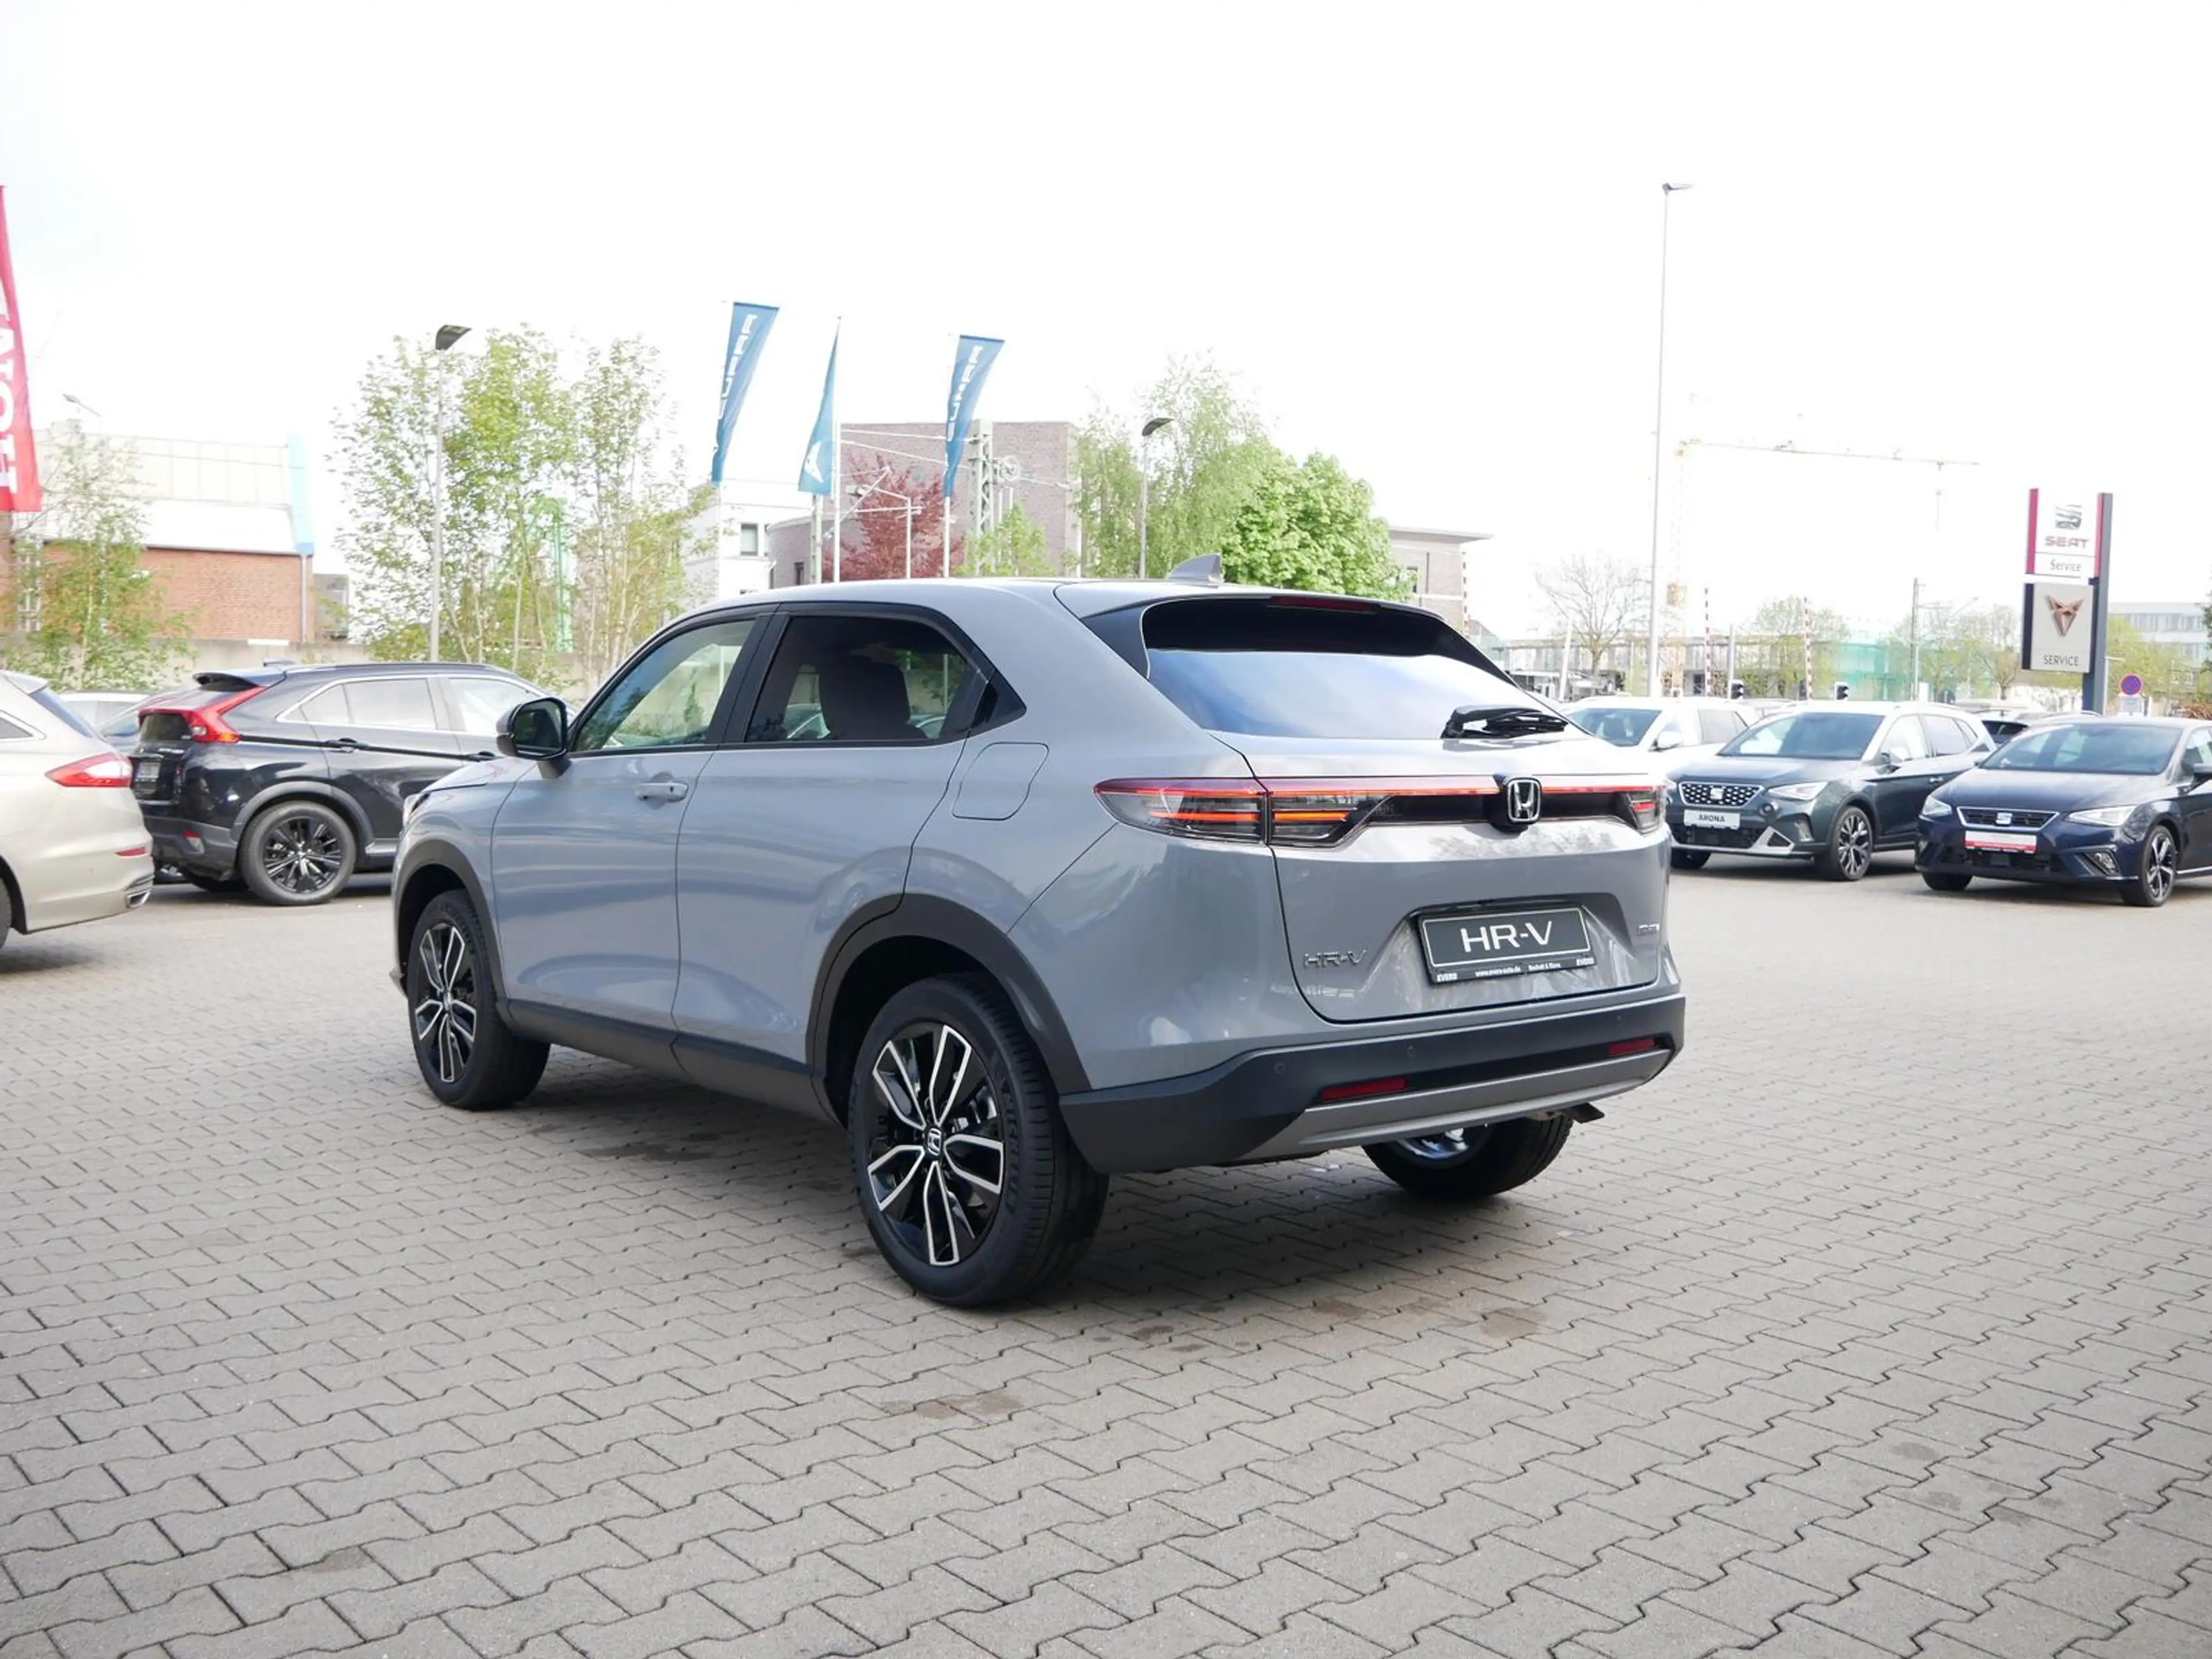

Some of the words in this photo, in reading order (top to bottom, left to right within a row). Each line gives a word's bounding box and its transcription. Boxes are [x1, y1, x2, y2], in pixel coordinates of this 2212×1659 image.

[2044, 536, 2090, 547] SEAT
[2050, 559, 2082, 572] Service
[2043, 654, 2079, 666] SERVICE
[1697, 814, 1725, 822] ARONA
[1460, 921, 1552, 952] HR-V
[1303, 948, 1369, 969] HR-V
